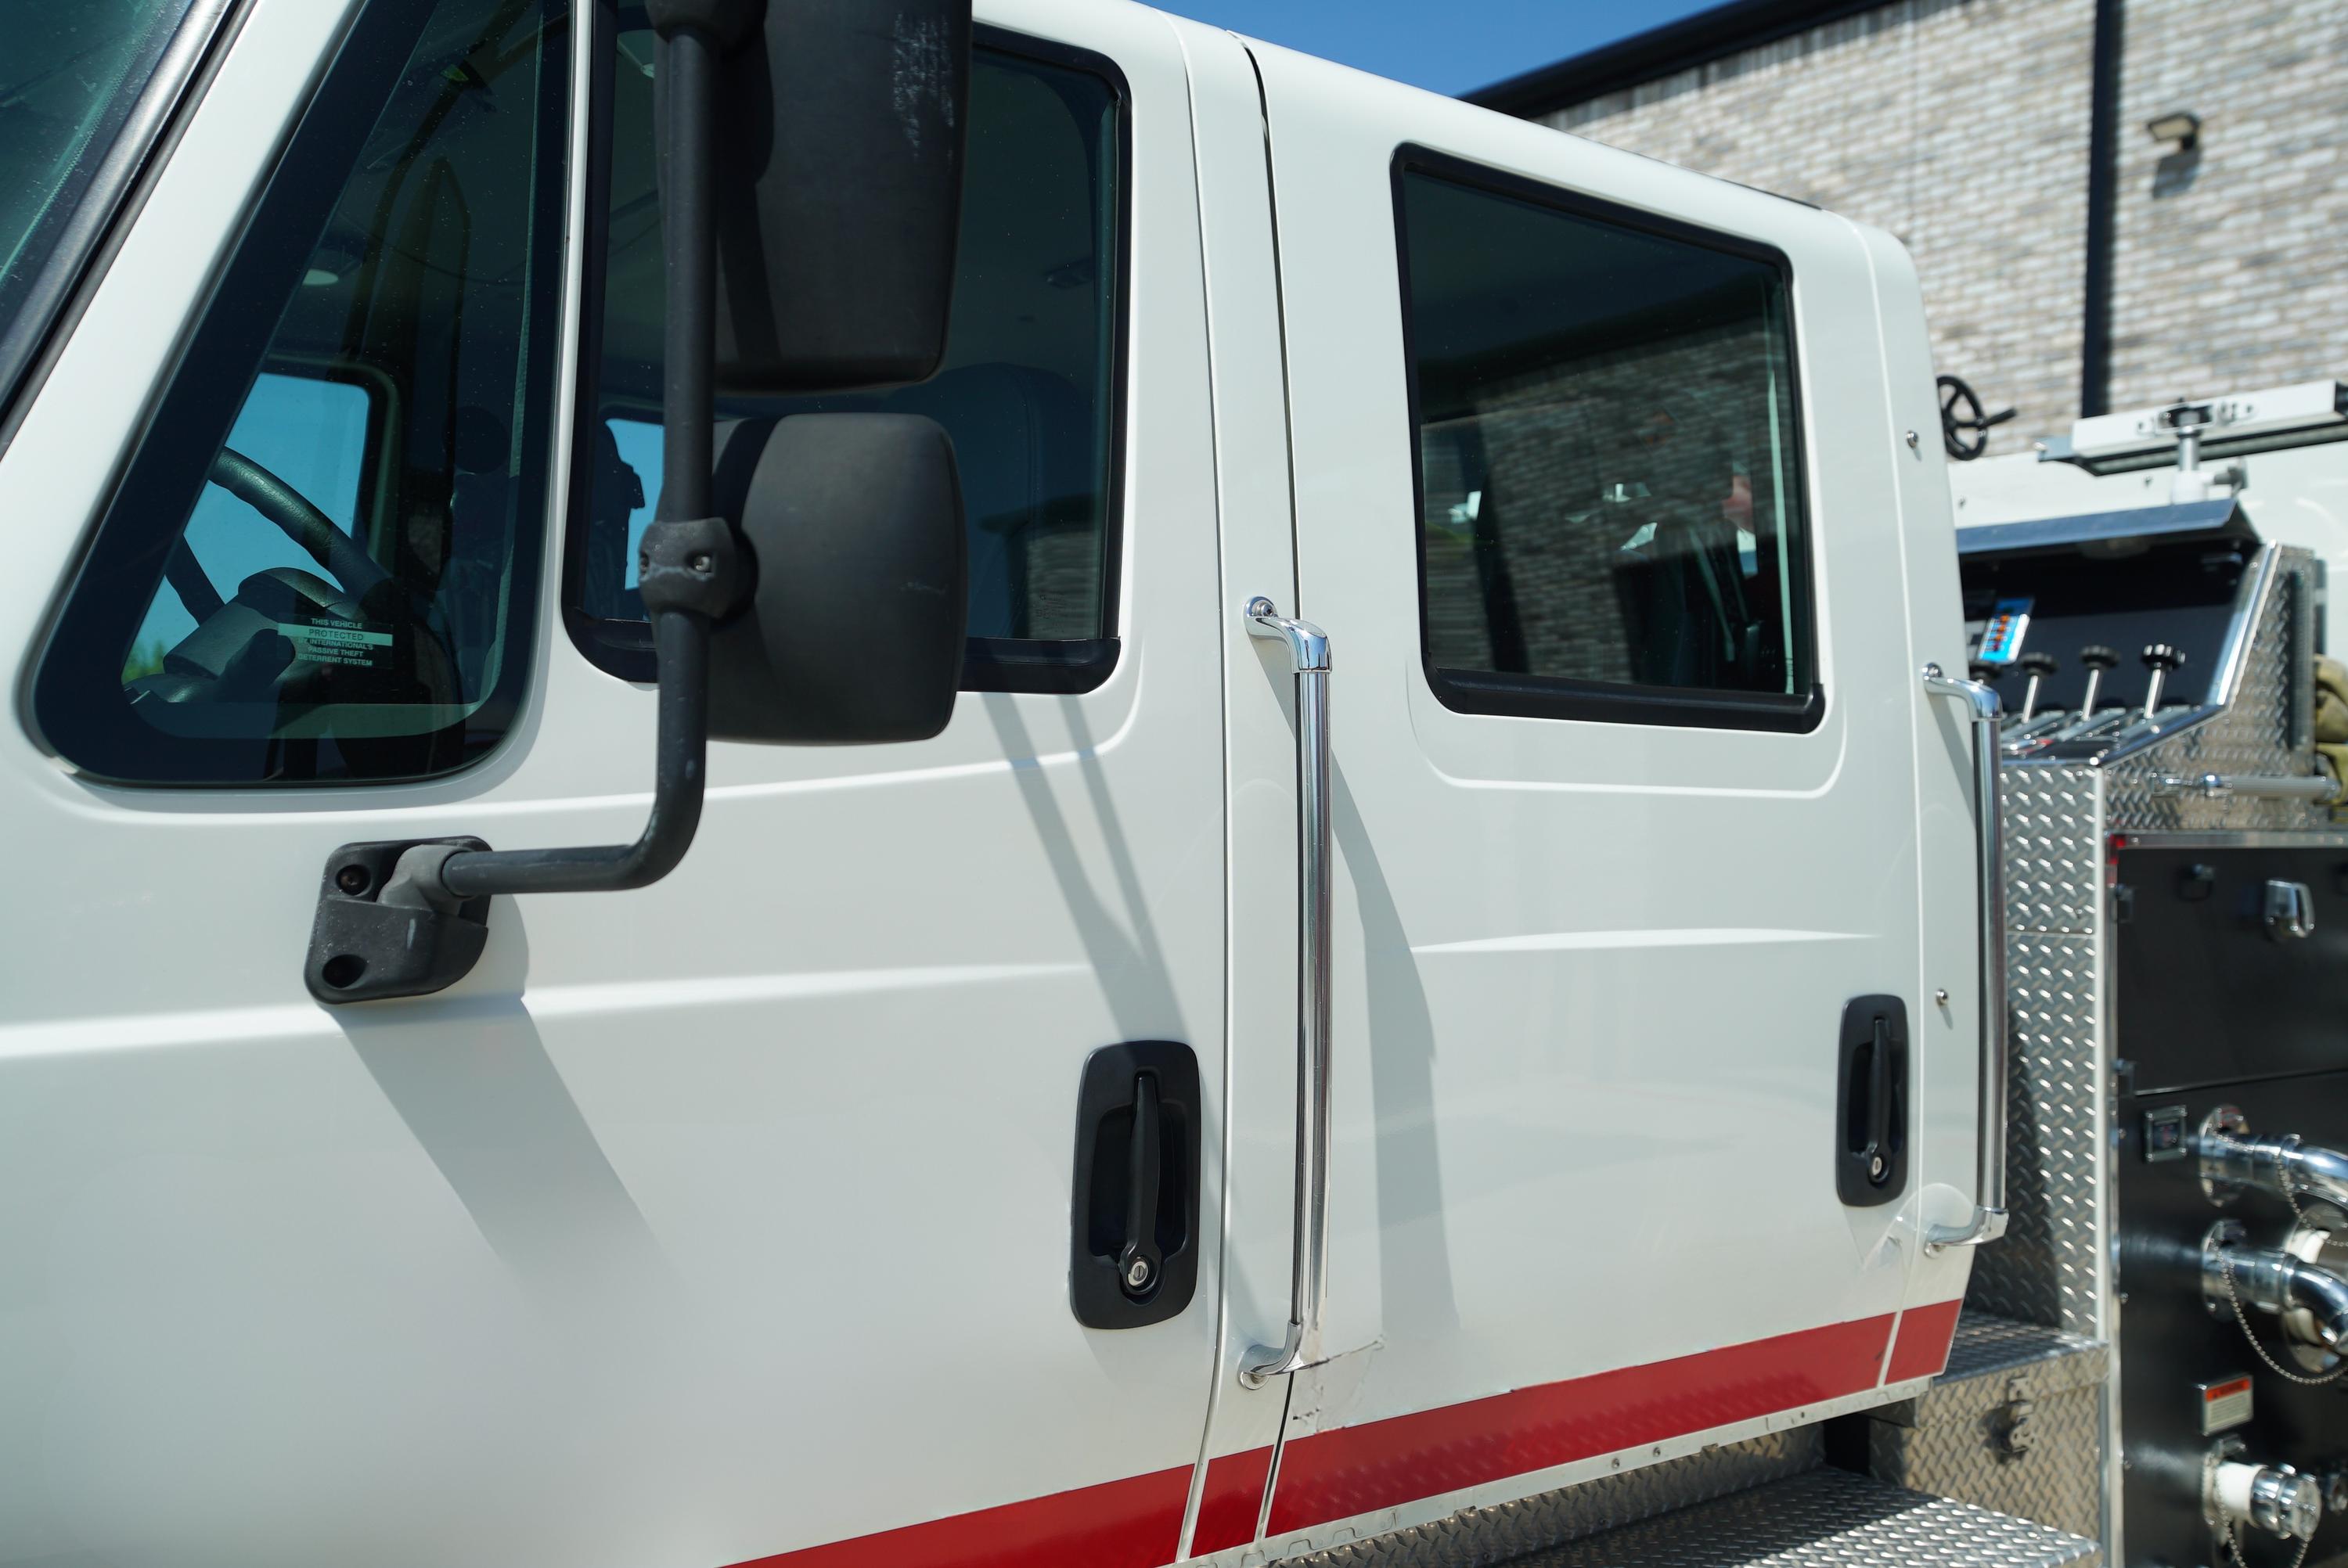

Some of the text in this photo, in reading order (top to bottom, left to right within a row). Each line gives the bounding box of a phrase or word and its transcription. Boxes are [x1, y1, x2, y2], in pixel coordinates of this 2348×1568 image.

[330, 620, 362, 628] VEHICLE
[309, 628, 364, 641] PROTECTED
[308, 646, 364, 657] PASSIVE THEFT
[298, 653, 373, 667] DETERRENT SYSTEM
